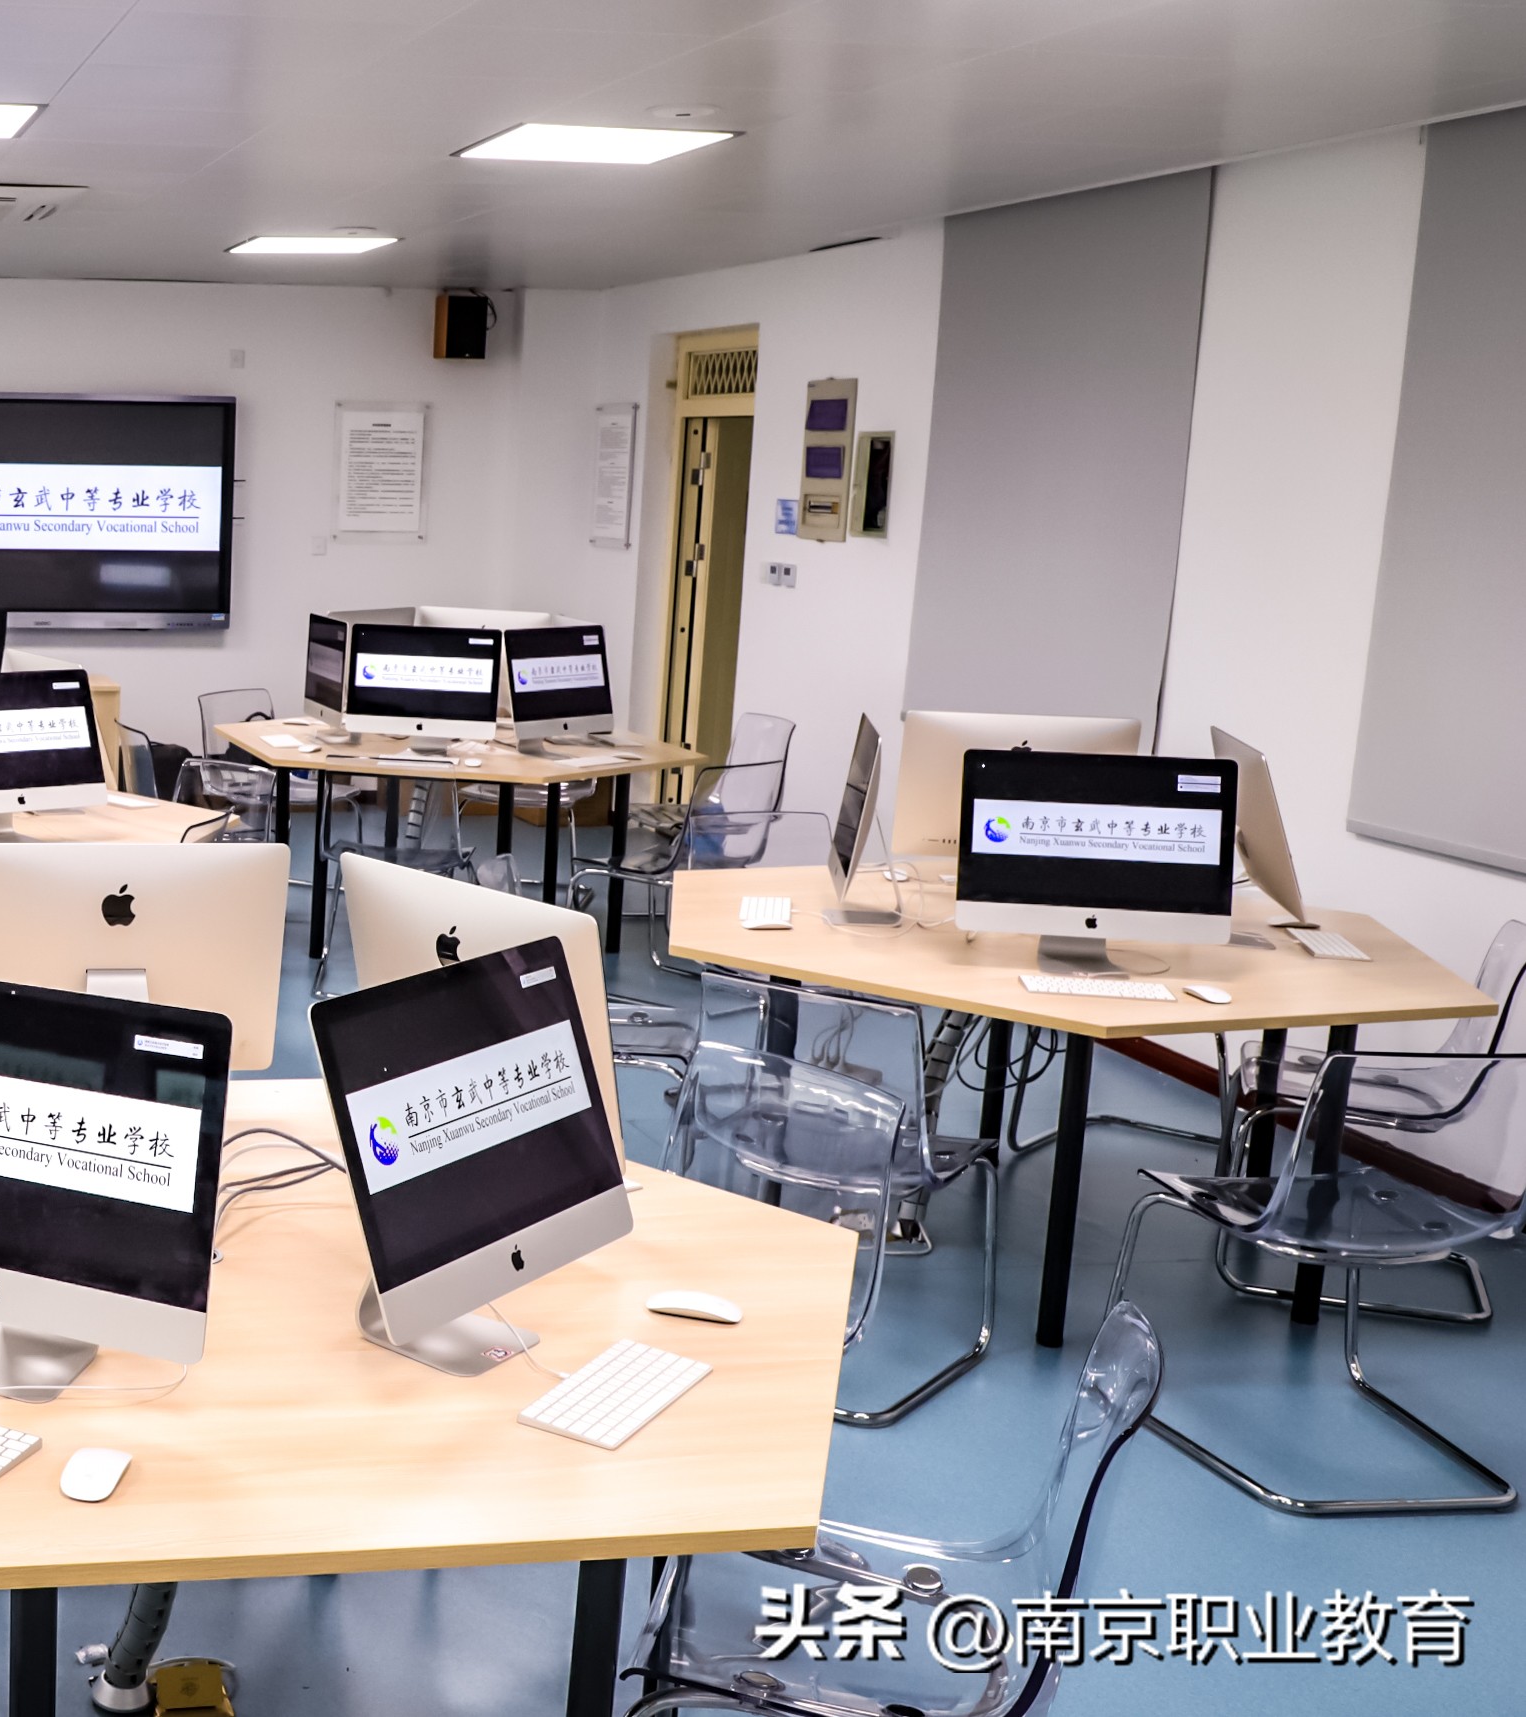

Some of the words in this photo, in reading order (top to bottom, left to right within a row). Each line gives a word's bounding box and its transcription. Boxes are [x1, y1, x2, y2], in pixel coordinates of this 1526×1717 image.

[33, 519, 93, 536] Secondary
[96, 520, 157, 534] Vocational
[160, 520, 200, 534] School
[1022, 816, 1206, 839] 南京市玄武中等专业学校
[1019, 835, 1051, 847] Nanjing
[1053, 837, 1086, 847] Xuanwu
[1088, 839, 1130, 851] Secondary
[1132, 841, 1175, 851] Vocational
[1177, 843, 1205, 853] School
[405, 1049, 569, 1128] 南京市玄武中等专业学校
[410, 1134, 443, 1156] Nanjing
[444, 1122, 475, 1144] Xuanwu
[476, 1108, 513, 1131] Secondary
[514, 1090, 551, 1115] Vocational
[552, 1080, 576, 1102] School
[57, 1153, 123, 1178] Vocational
[127, 1165, 171, 1187] School
